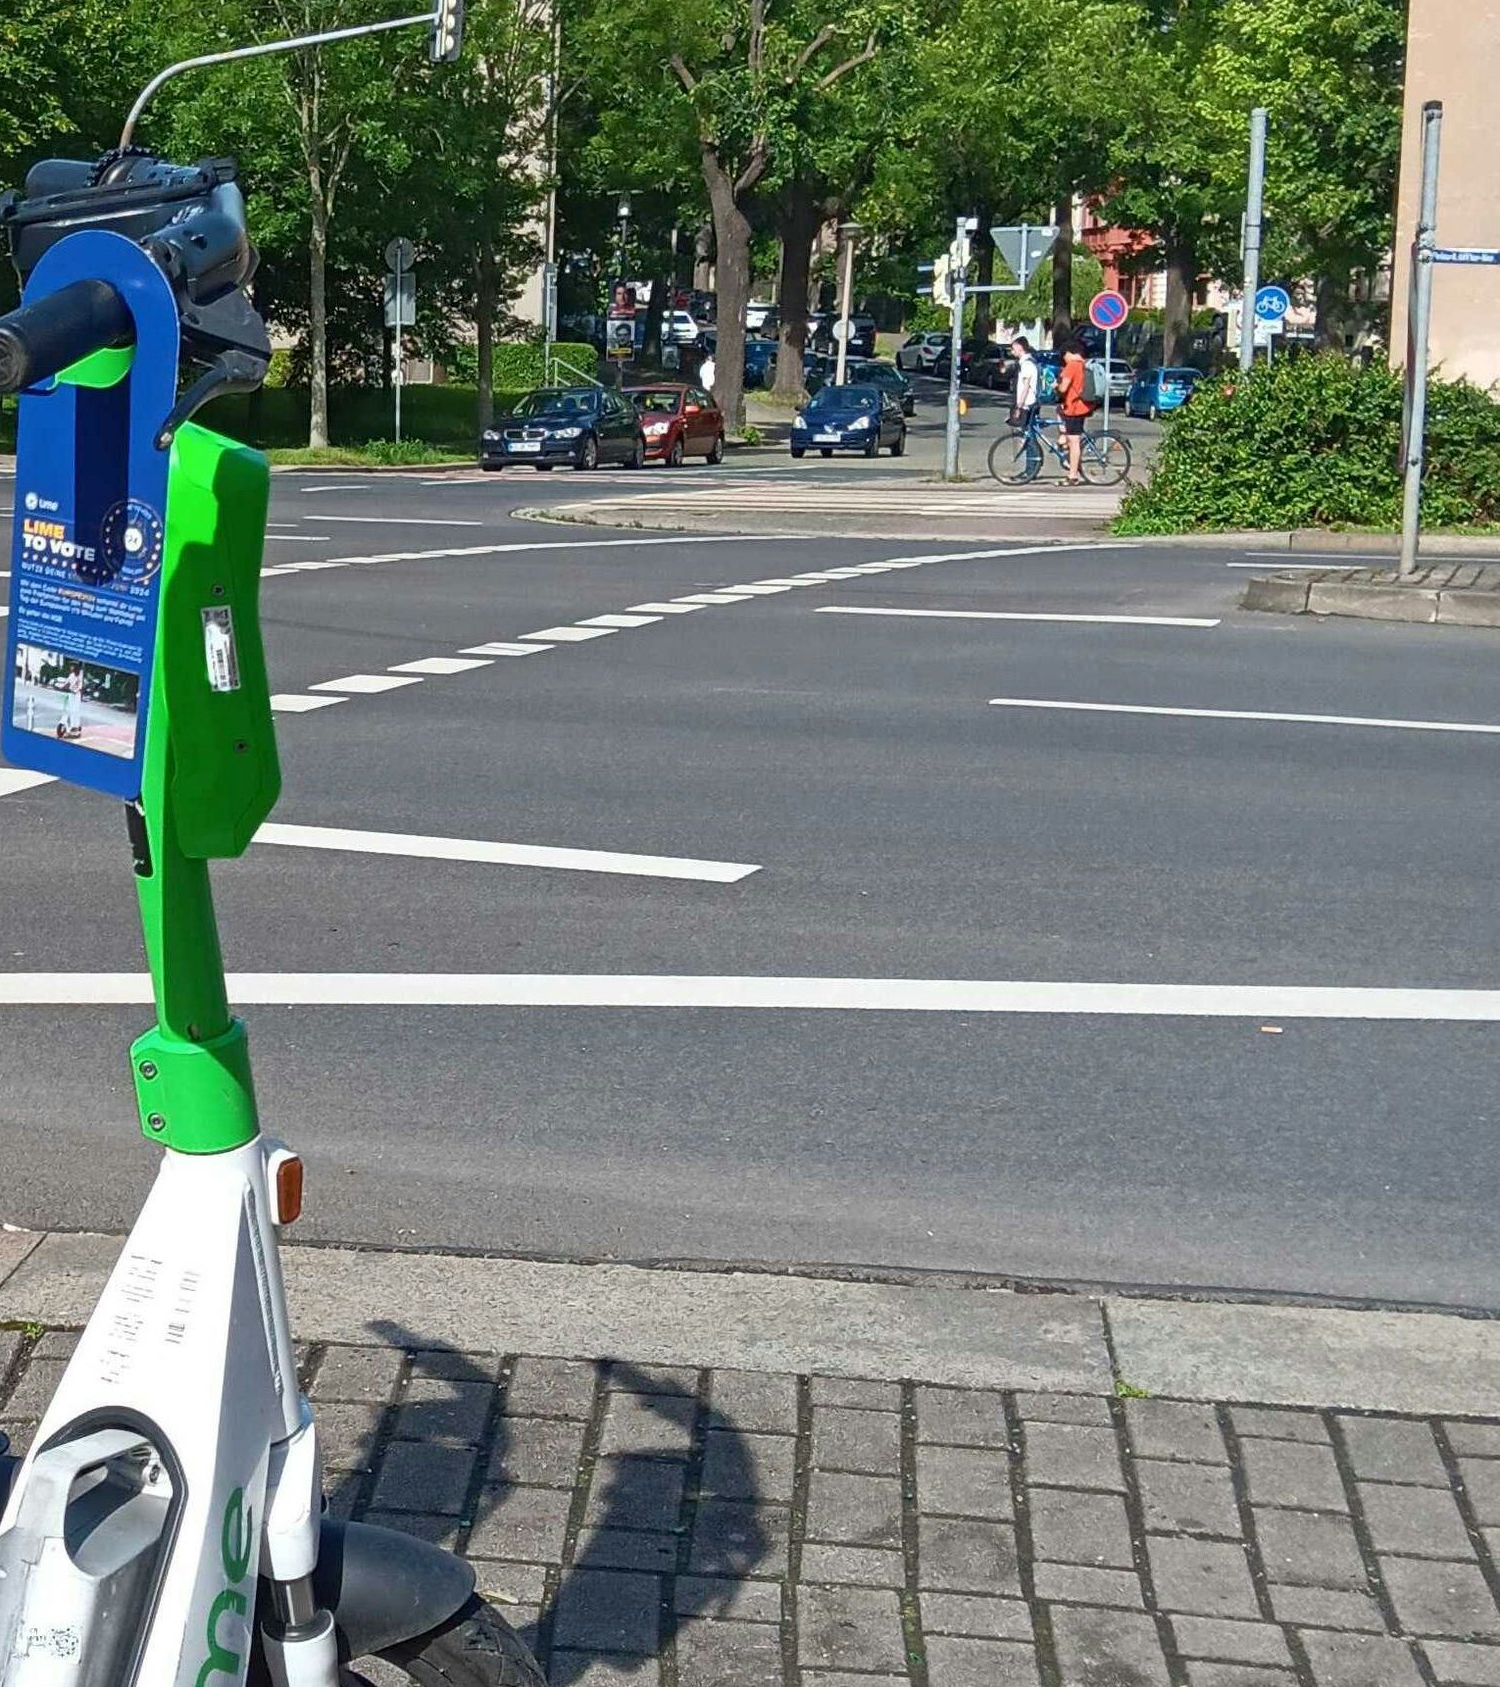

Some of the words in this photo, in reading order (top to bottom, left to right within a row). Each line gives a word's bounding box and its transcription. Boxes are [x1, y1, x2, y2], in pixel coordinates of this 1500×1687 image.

[23, 518, 65, 539] LIME
[23, 533, 47, 551] TO
[50, 539, 96, 562] VOTE
